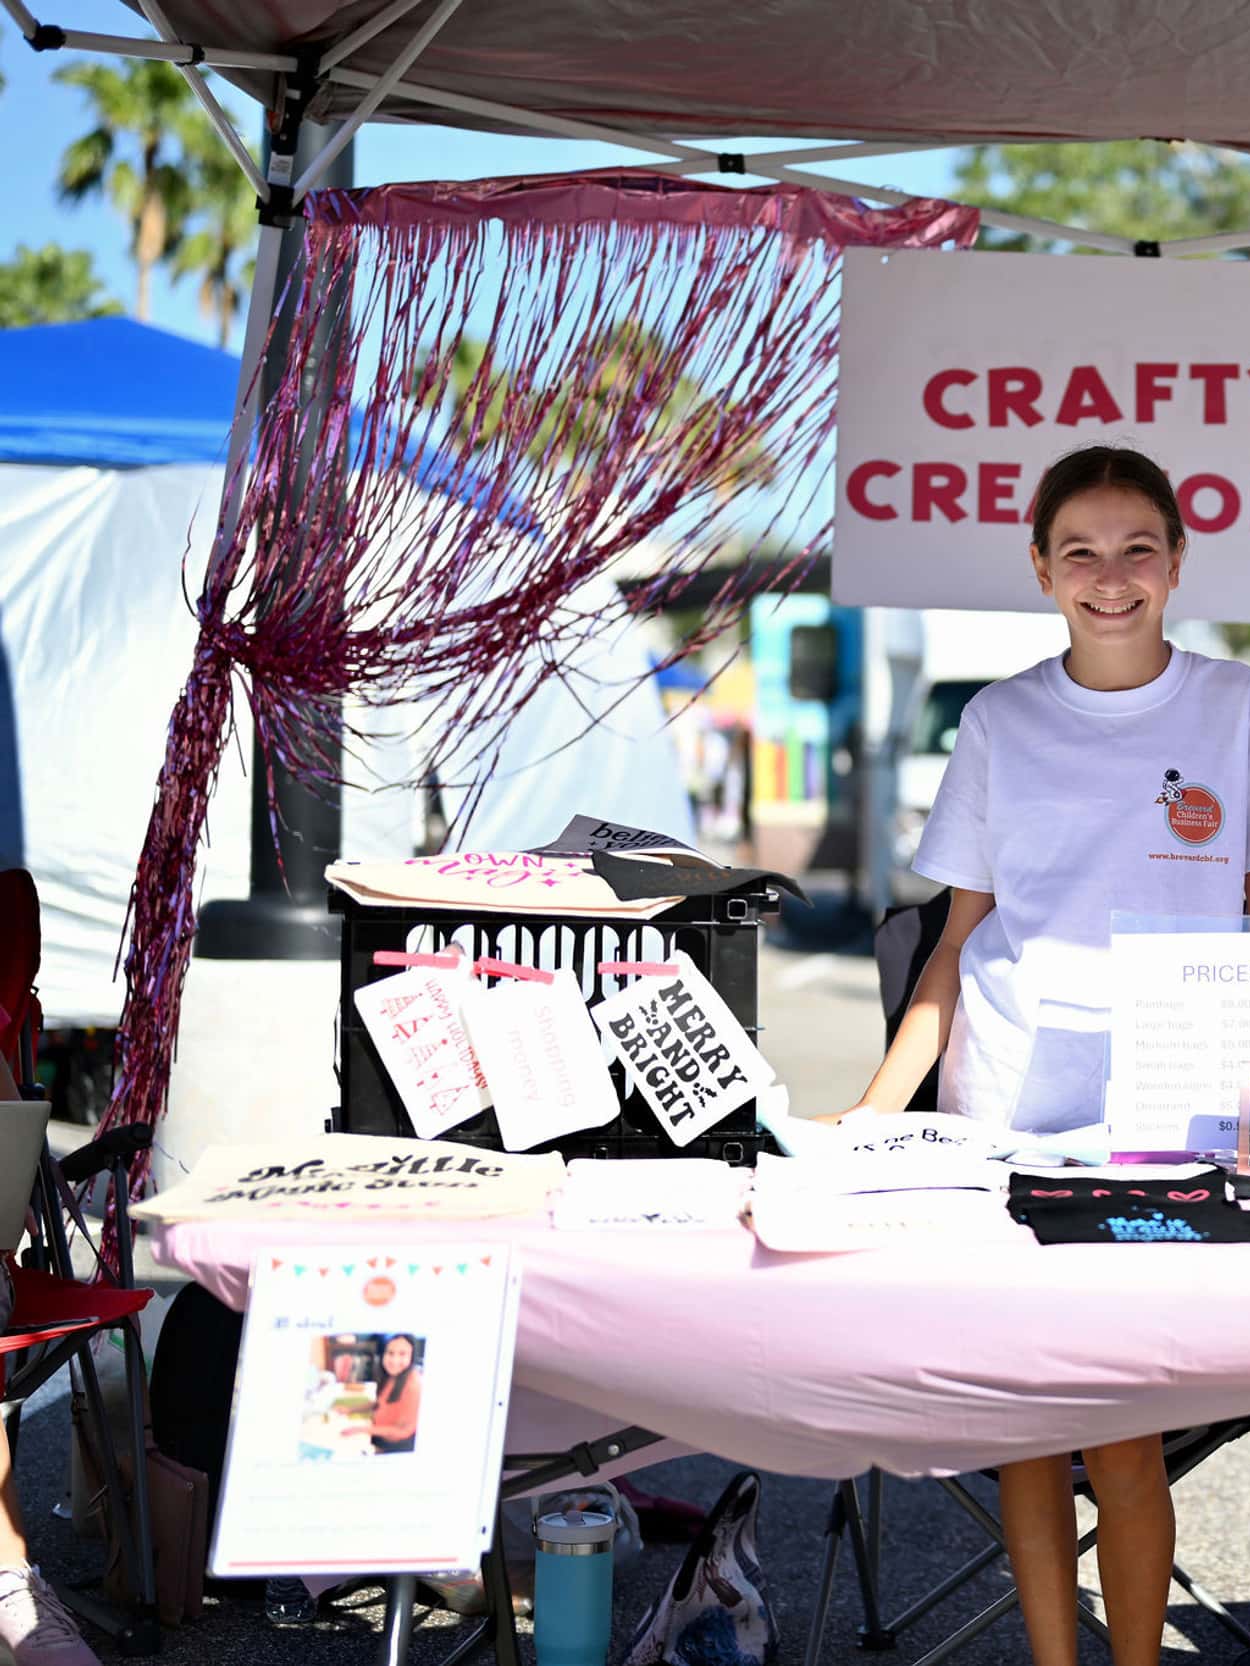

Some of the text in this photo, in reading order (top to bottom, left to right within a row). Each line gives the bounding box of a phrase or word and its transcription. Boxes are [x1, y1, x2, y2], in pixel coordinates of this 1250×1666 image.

[609, 1013, 695, 1126] BRIGHT
[646, 1022, 700, 1082] AND
[658, 979, 748, 1089] MERRY
